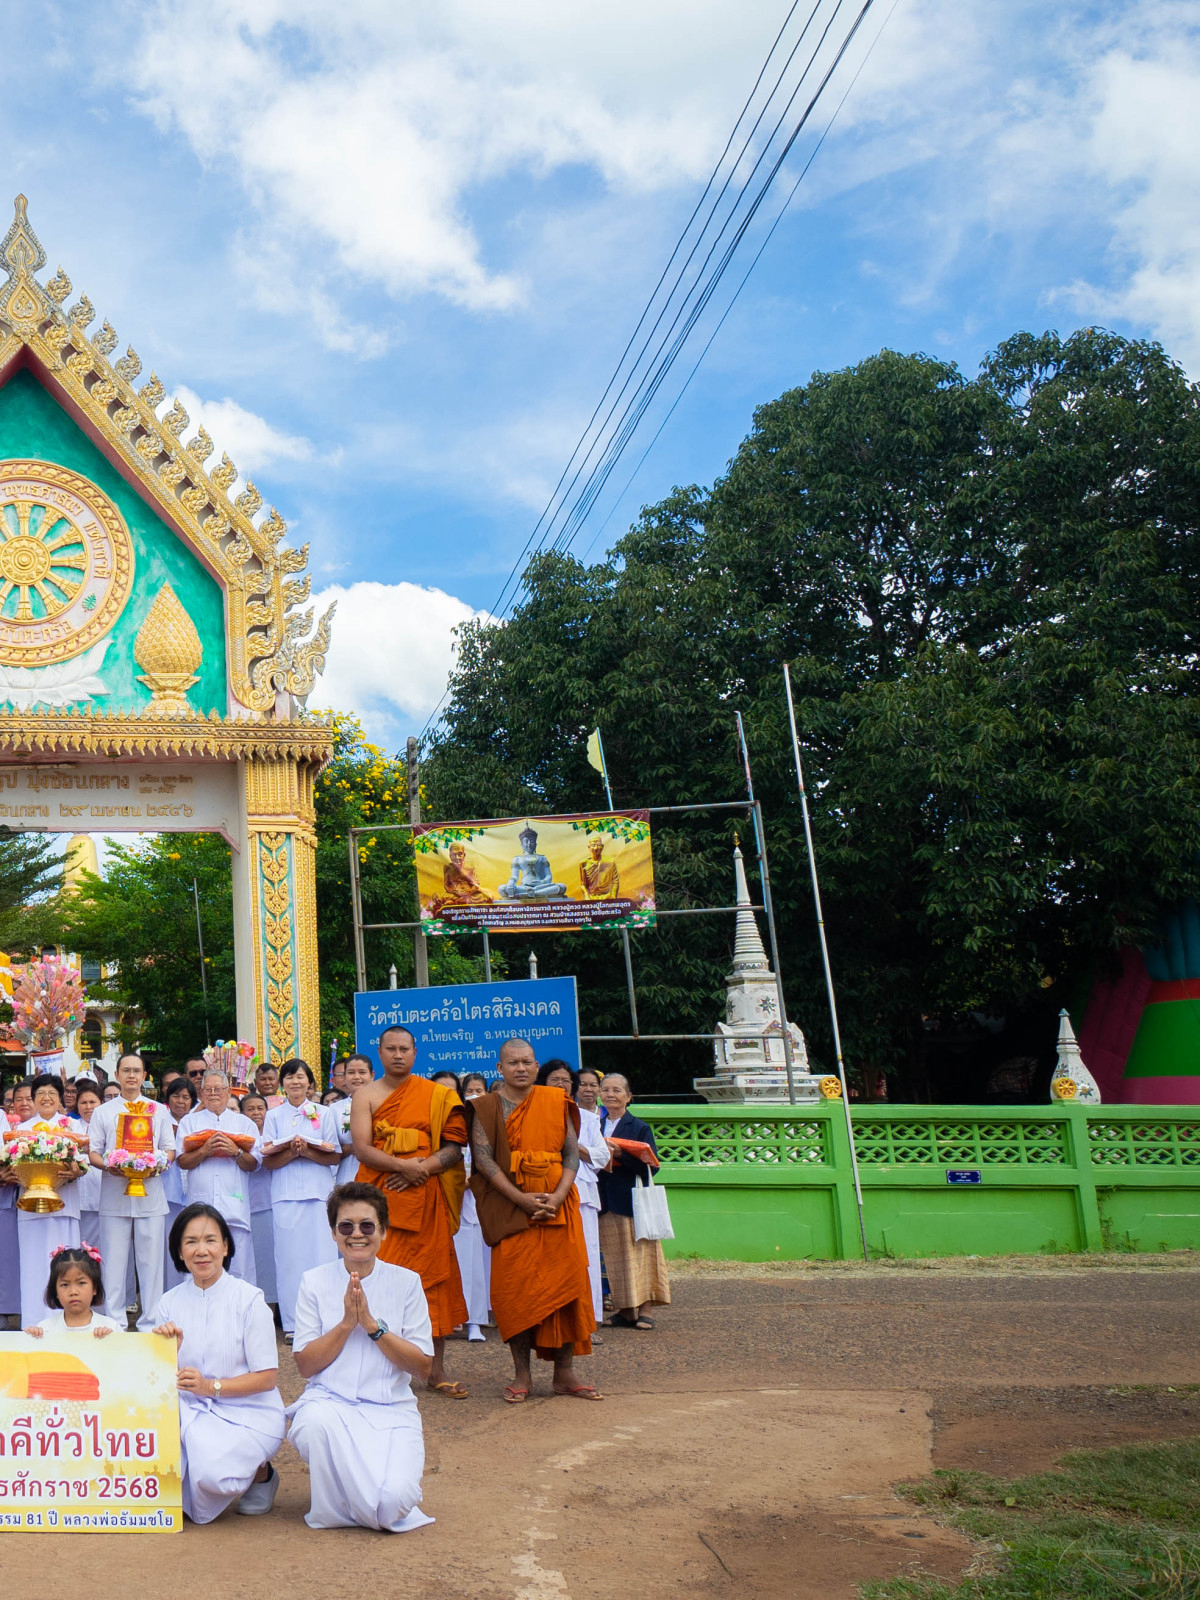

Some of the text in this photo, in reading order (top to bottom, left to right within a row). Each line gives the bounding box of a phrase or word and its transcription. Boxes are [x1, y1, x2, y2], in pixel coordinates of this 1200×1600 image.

[83, 521, 111, 579] แห่งชาติ
[91, 804, 142, 817] เมษายน
[368, 997, 561, 1025] วัดซับตะคร้อไตรสิริมงคล
[422, 1028, 474, 1043] ต.ไทยเจริญ
[484, 1026, 563, 1042] อ.หนองบุญมาก
[428, 1045, 497, 1061] จ.นครราชสีมา
[99, 1476, 159, 1498] 2568
[27, 1513, 43, 1526] 81
[48, 1509, 58, 1526] ปี
[63, 1508, 174, 1527] หลวงพ่อธัมมชโย
